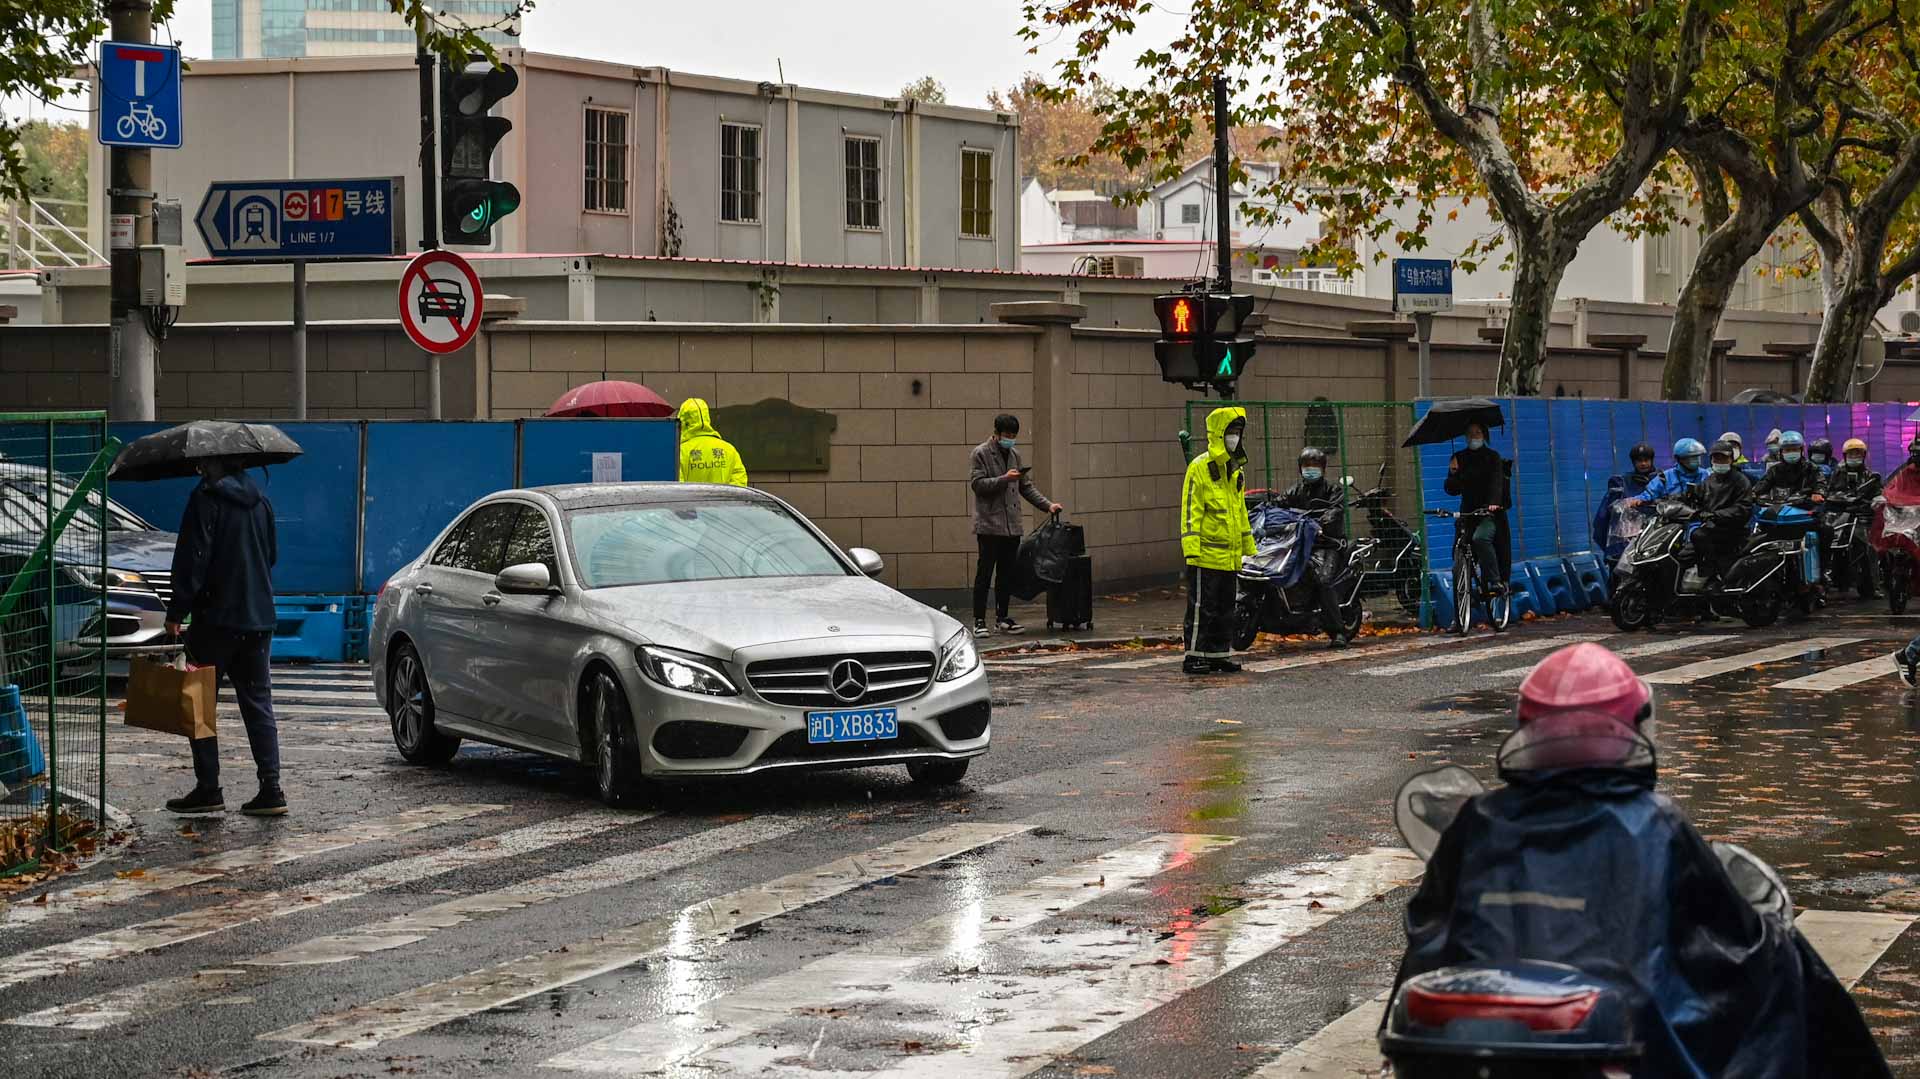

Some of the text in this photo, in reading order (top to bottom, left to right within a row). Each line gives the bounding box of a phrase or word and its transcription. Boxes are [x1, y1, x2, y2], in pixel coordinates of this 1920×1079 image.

[343, 190, 385, 216] 号线
[290, 231, 335, 244] LINE 1/7
[690, 461, 727, 470] POLICE
